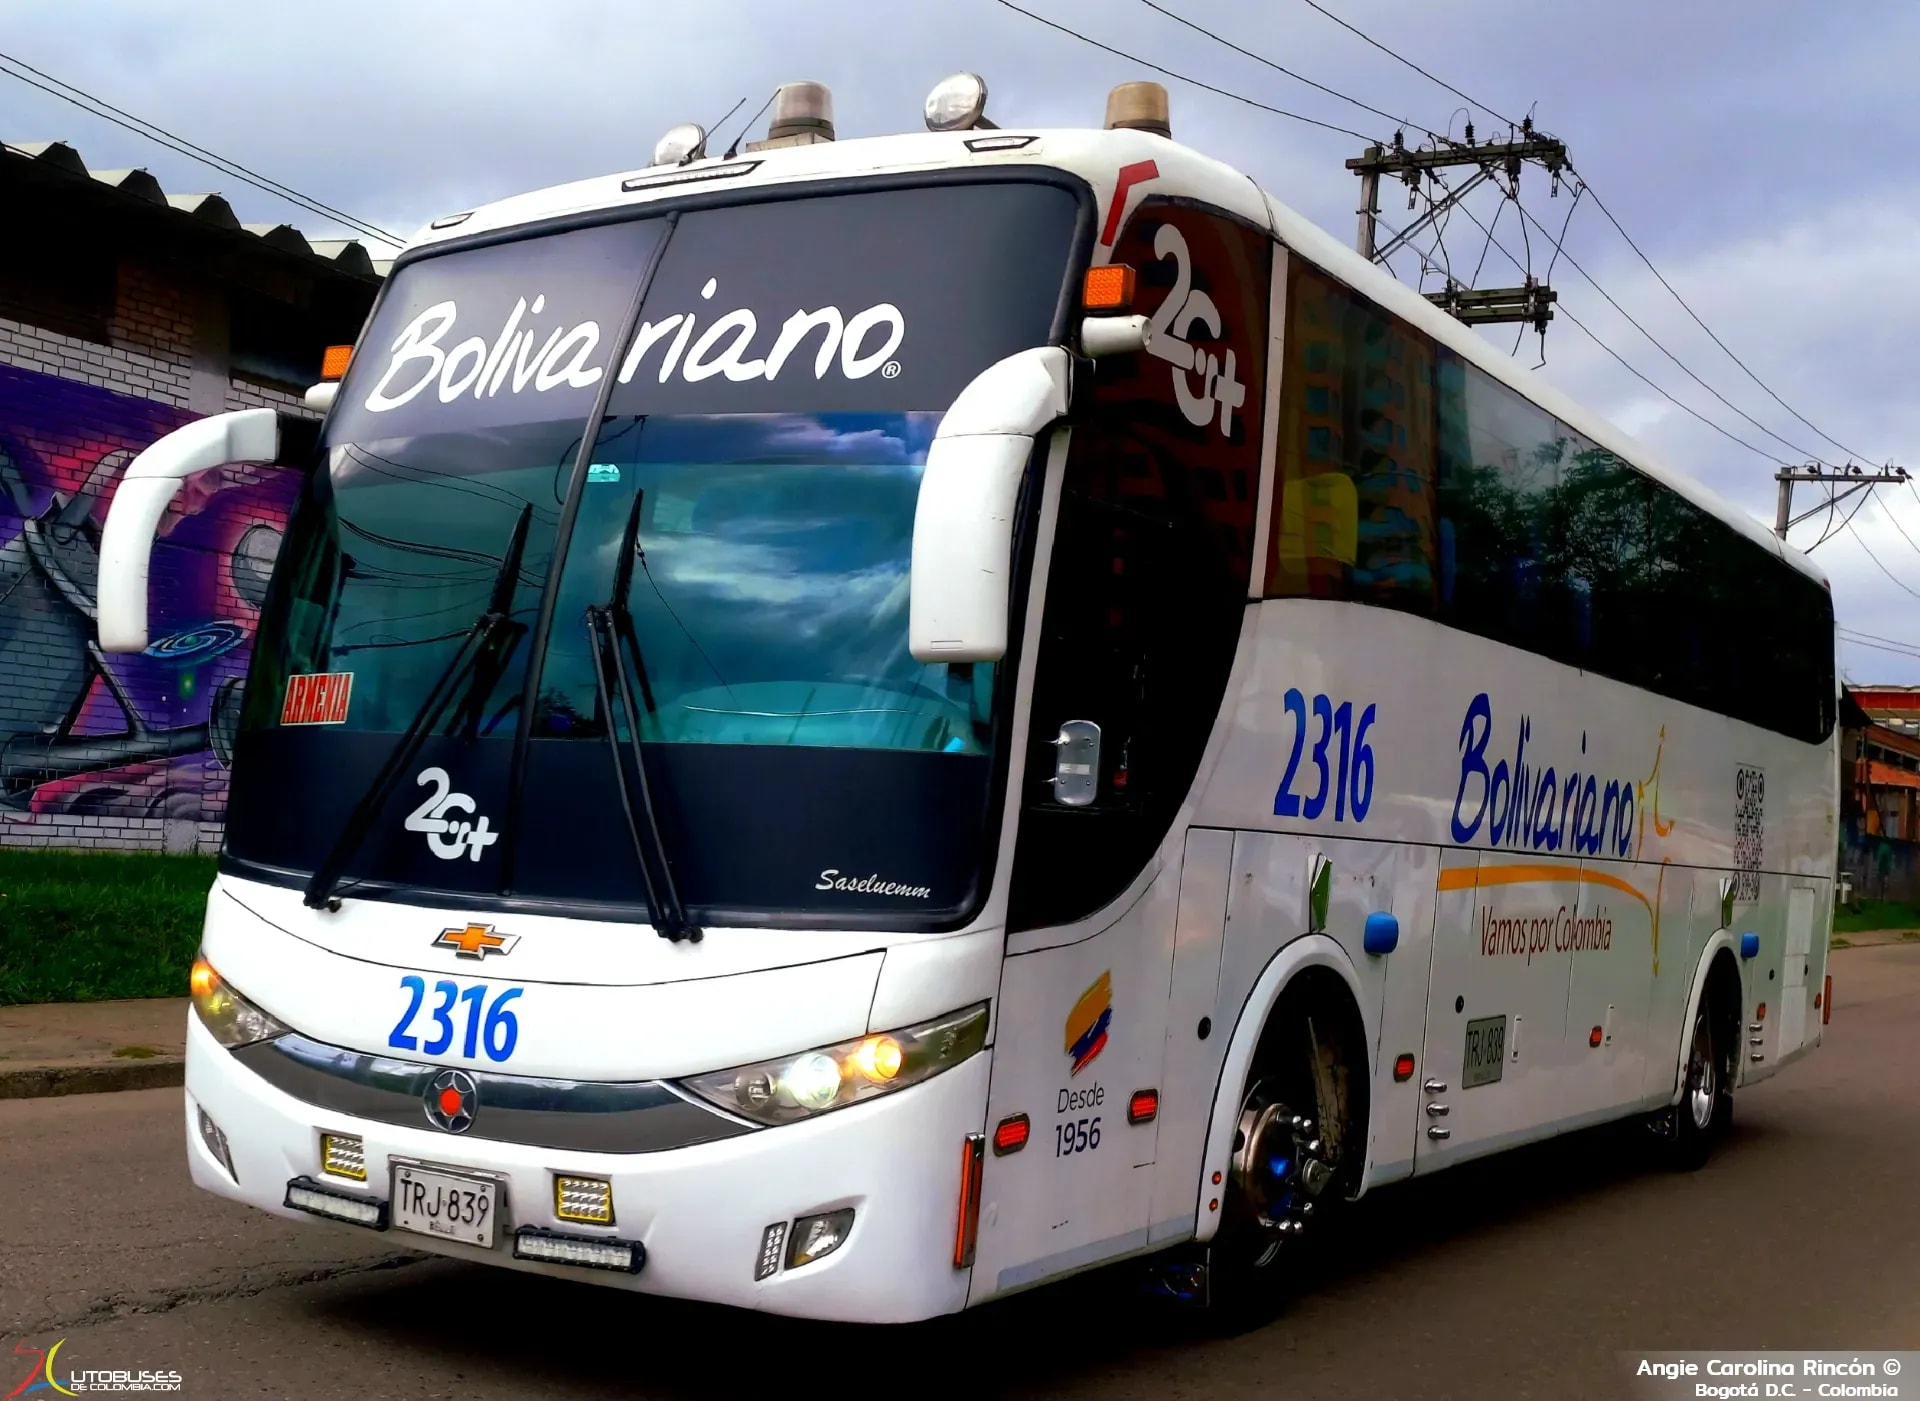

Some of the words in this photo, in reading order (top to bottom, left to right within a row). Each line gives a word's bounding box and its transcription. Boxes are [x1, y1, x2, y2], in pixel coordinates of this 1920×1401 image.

[283, 675, 351, 723] ARMENIA
[1273, 687, 1377, 823] 2316
[1481, 905, 1527, 956] Vamos
[1527, 916, 1554, 967] por
[1554, 903, 1612, 953] Colombia
[388, 975, 524, 1063] 2316
[1057, 1081, 1105, 1114] Desde
[1055, 1117, 1102, 1158] 1956
